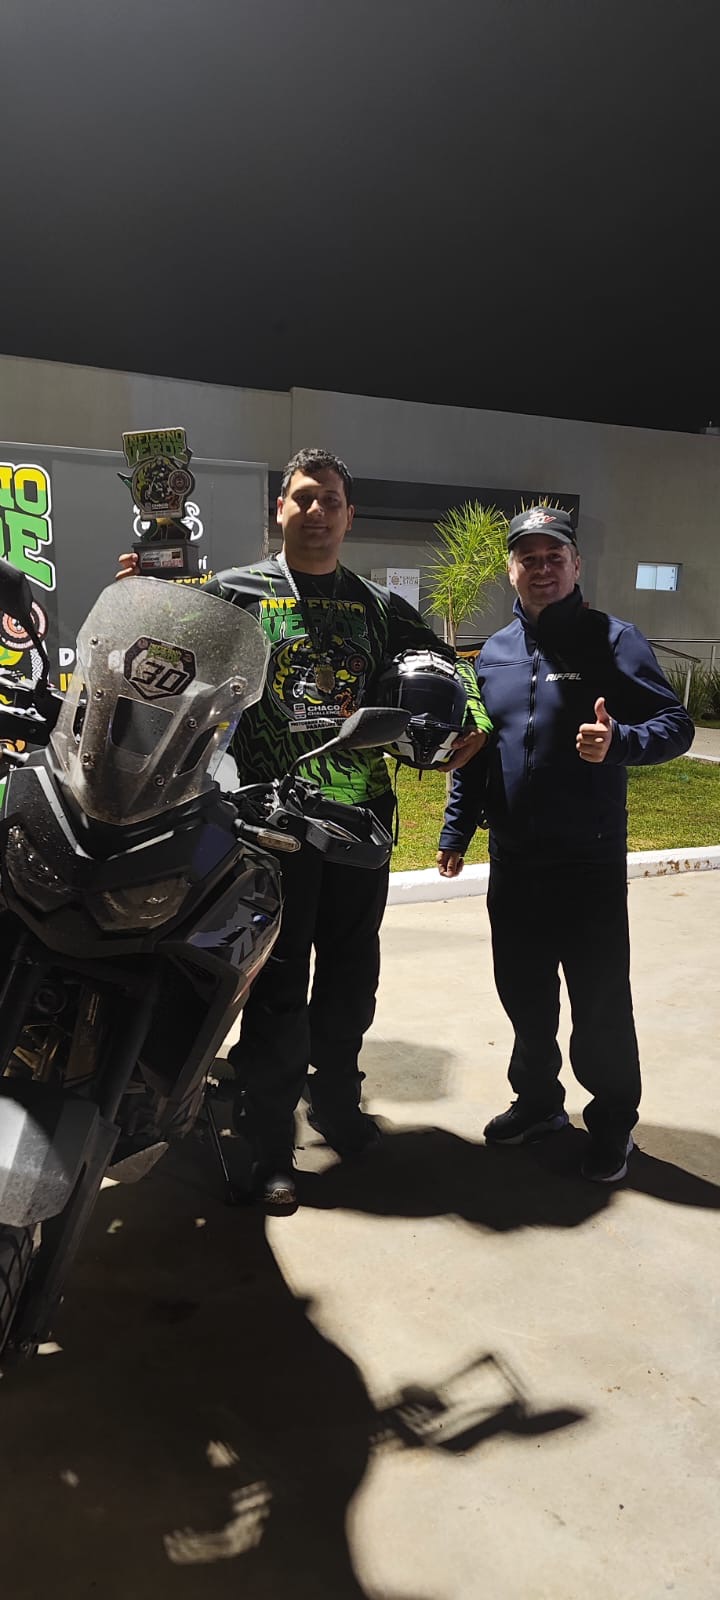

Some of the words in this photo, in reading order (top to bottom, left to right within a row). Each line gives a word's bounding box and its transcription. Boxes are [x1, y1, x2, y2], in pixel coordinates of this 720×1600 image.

[125, 429, 183, 446] INFIERNO
[126, 441, 188, 467] VERDE
[132, 661, 188, 692] 30
[545, 673, 582, 682] RIFFEL
[307, 704, 340, 712] CHACO
